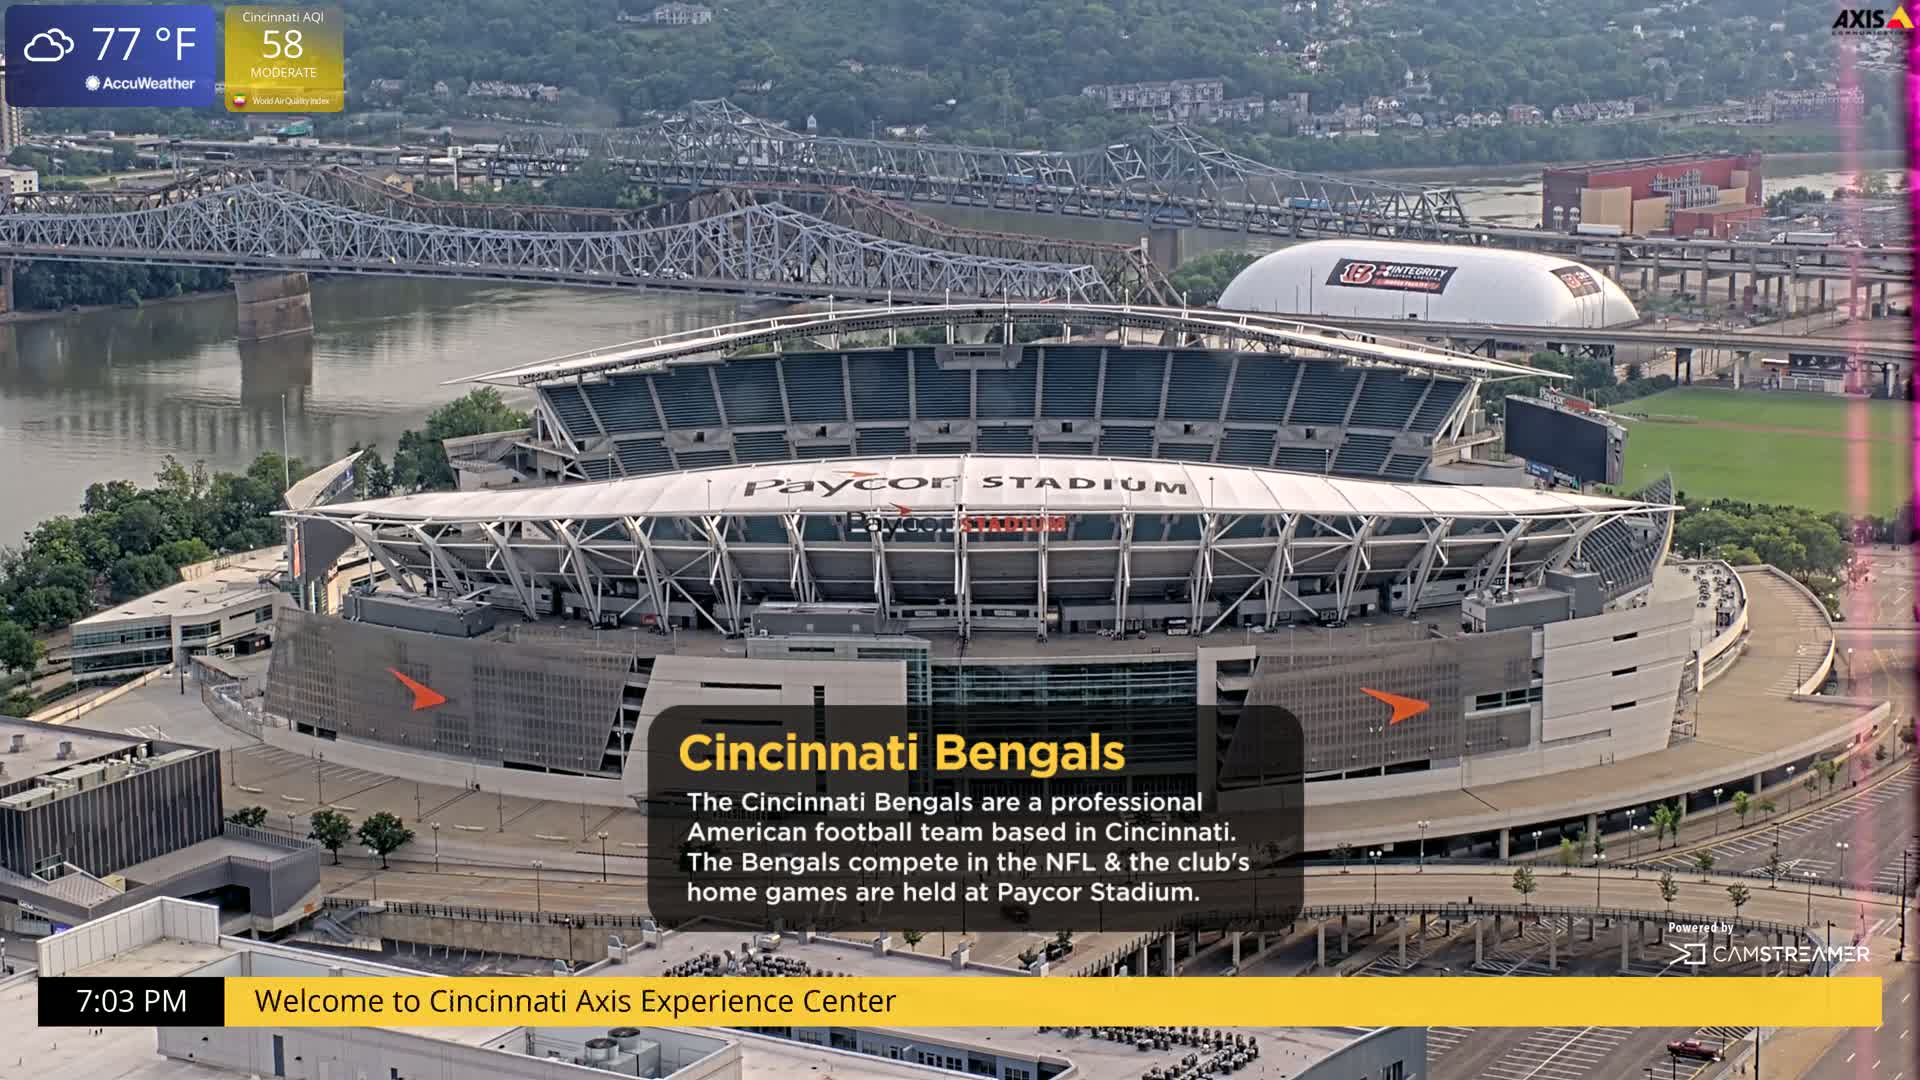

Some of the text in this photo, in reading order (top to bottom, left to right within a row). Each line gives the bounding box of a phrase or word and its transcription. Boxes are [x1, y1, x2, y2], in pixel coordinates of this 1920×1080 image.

[1391, 265, 1448, 278] INTEGRITY
[744, 475, 1187, 497] Paycor STADIUM
[846, 511, 1067, 539] Paycor STADIUM
